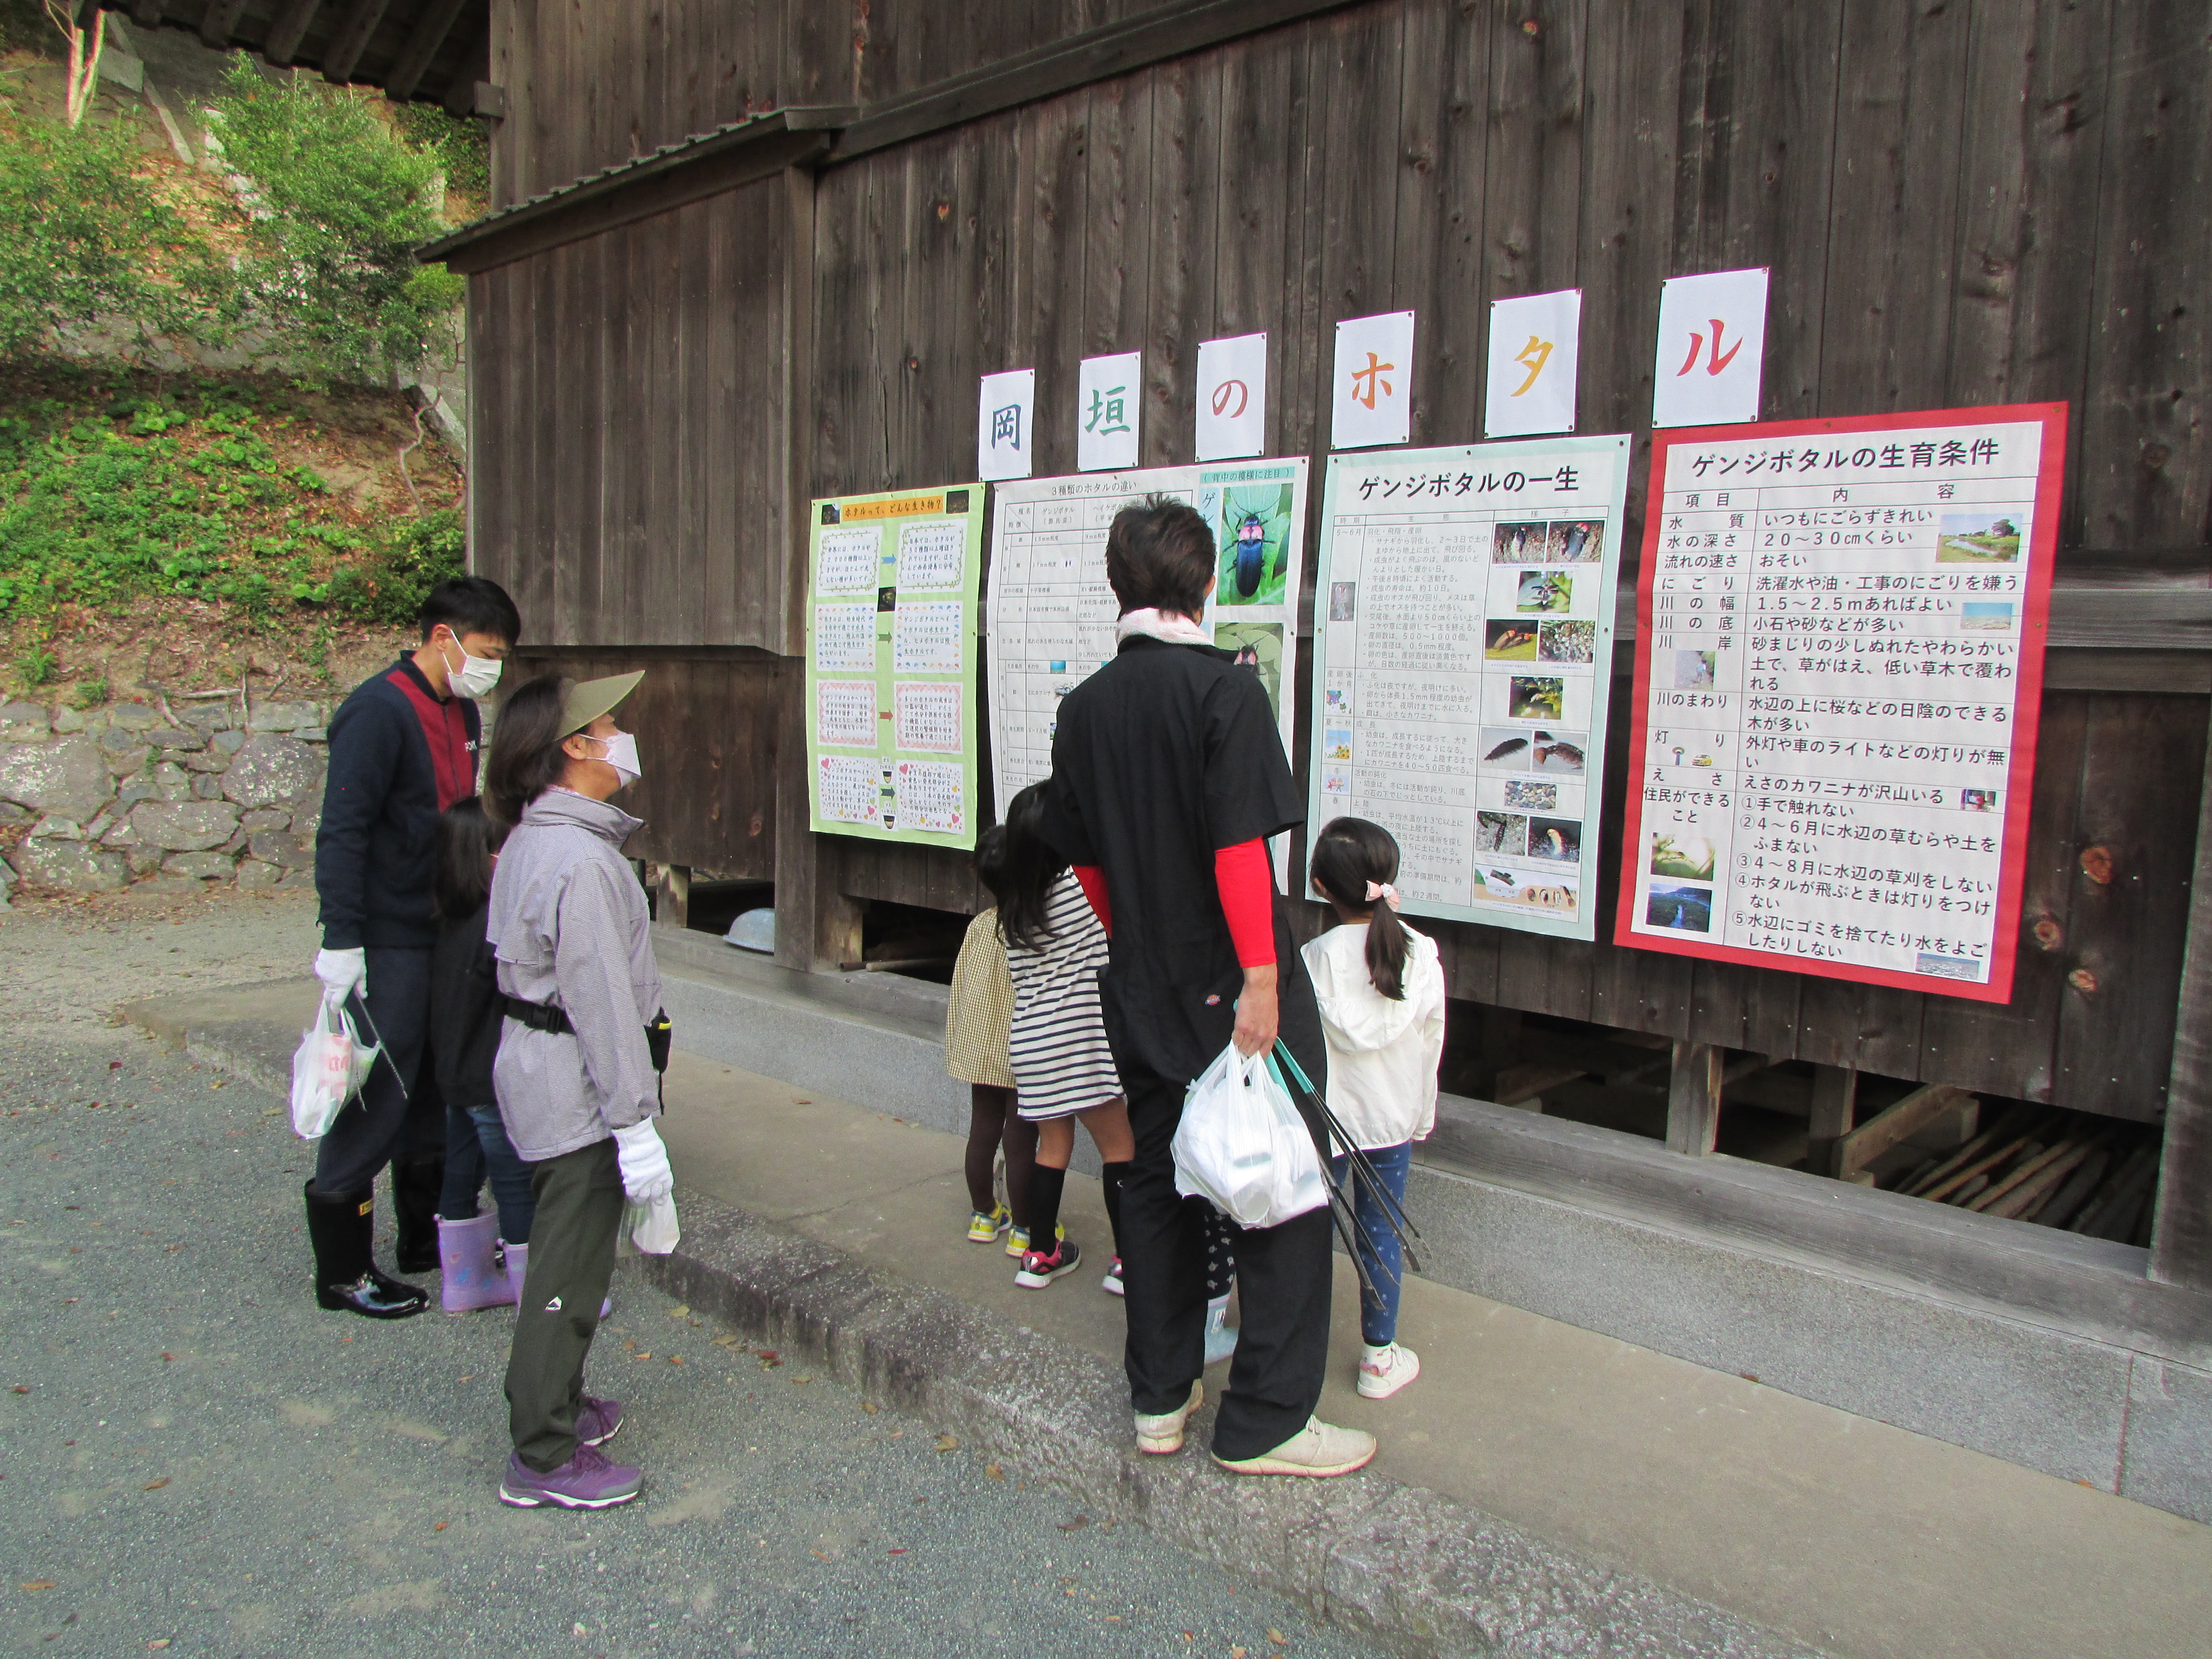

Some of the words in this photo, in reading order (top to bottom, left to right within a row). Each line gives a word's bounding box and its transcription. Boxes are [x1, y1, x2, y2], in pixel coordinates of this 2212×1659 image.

[990, 403, 1022, 451] 岡
[1084, 386, 1130, 436] 垣
[1212, 379, 1248, 418] の
[1350, 352, 1395, 410] ホ
[1510, 336, 1553, 397] タ
[1676, 318, 1743, 376] ル
[1691, 439, 1999, 478] ゲンジボタルの生育条件
[1052, 481, 1137, 496] 3種類のホタルの違い
[1359, 465, 1579, 501] ゲンジボタルの一生
[1764, 508, 1933, 527] いつもにごらずきれい
[1667, 532, 1737, 548] 水の深さ
[1663, 553, 1737, 569] 流れの速さ
[1759, 553, 1806, 567] おそい
[1661, 576, 1732, 590] にごり
[1756, 574, 2017, 591] 洗濯水や油・工事のにごりを嫌う
[1660, 596, 1735, 611] 川の幅
[1659, 615, 1734, 630] 川の底
[1753, 615, 1904, 633] 小石や砂などが多い
[1751, 636, 2014, 657] 砂まじりの少しぬれたやわらかい
[1750, 656, 2012, 680] 土で、草がはえ、低い草木で覆わ
[1750, 676, 1779, 691] れる
[1657, 692, 1728, 709] 川のまわり
[1748, 696, 2007, 723] 水辺の上に桜などの日陰のできる
[1747, 715, 1809, 733] 木が多い
[1746, 734, 2005, 766] 外灯や車のライトなどの灯りが無
[1746, 756, 1759, 768] い
[1643, 787, 1730, 808] 住民ができる
[1743, 775, 1944, 805] えさのカワニナが沢山いる
[1741, 795, 1854, 818] ①手で触れない
[1672, 809, 1699, 824] こと
[1753, 837, 1818, 854] ふまない
[1734, 872, 1990, 916] ④ホタルが飛ぶときは灯りをつけ
[1750, 894, 1780, 909] ない
[1731, 911, 1989, 958] ⑤水辺にゴミを捨てたり水をよご
[1748, 935, 1842, 958] したりしない
